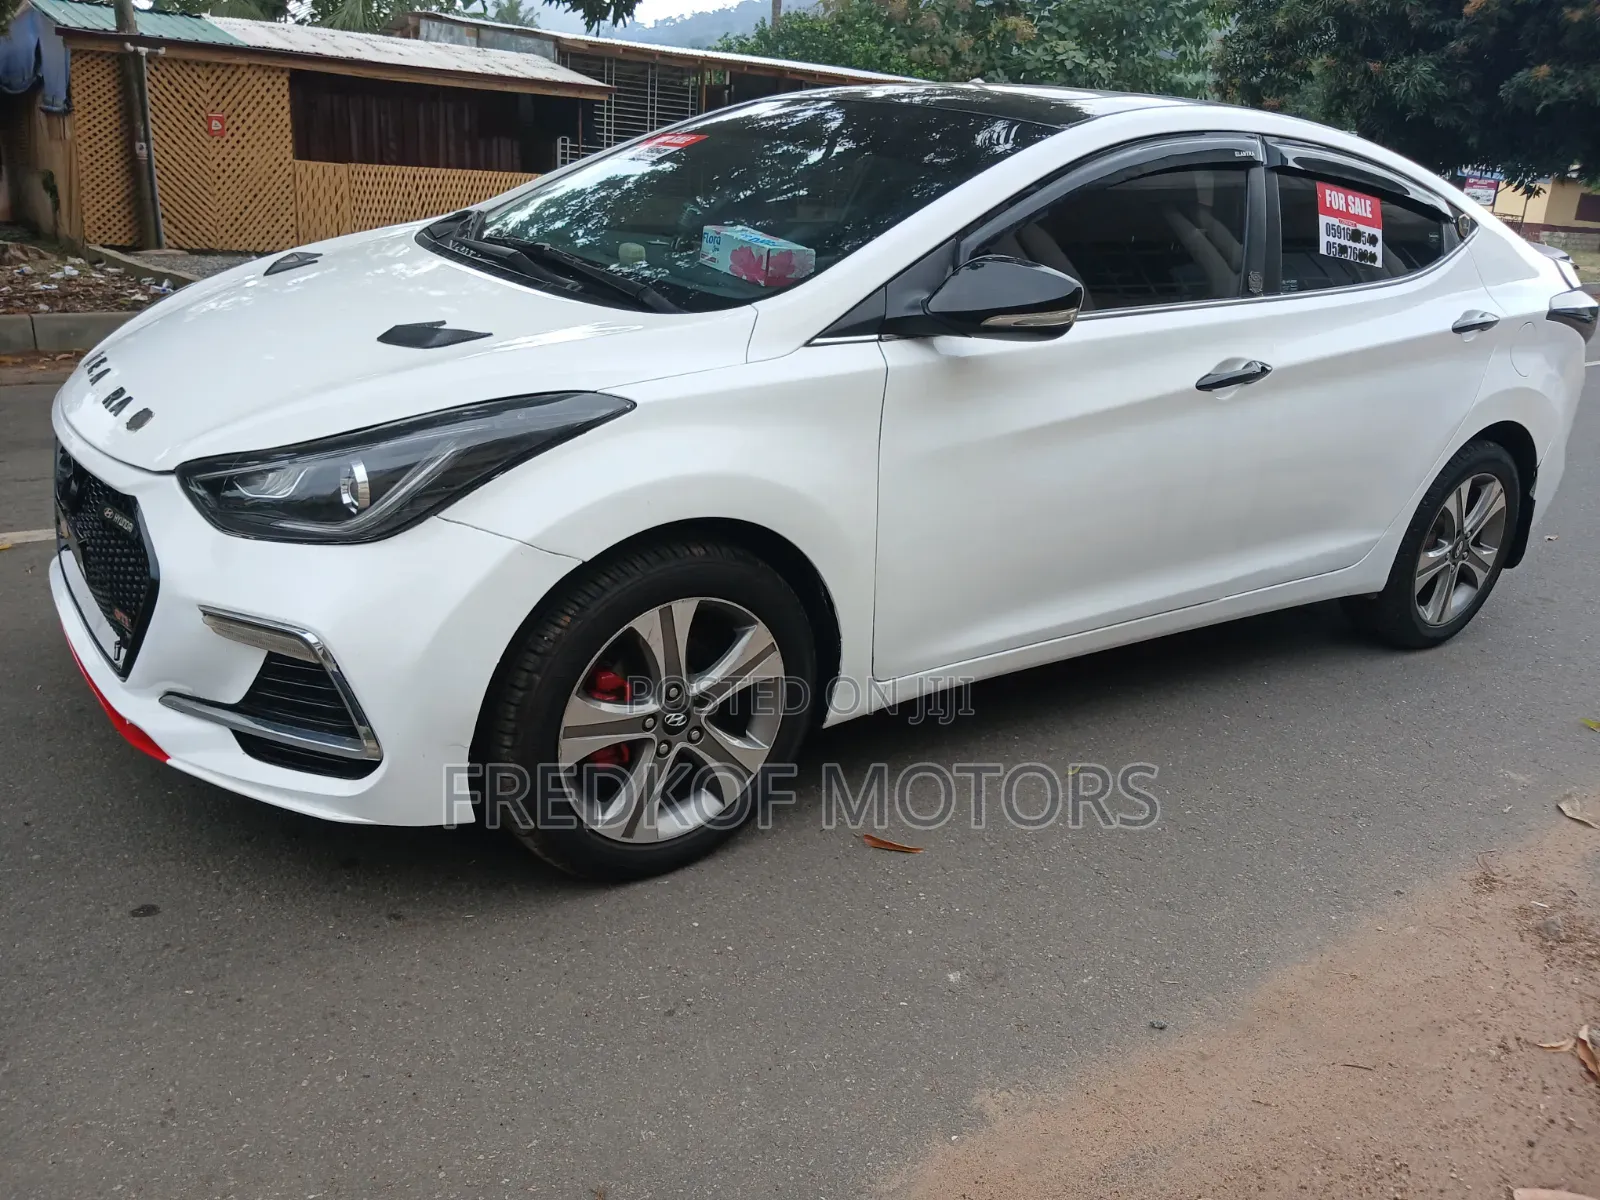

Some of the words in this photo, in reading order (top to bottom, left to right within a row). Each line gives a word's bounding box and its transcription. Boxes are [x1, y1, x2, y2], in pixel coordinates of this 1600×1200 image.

[1325, 189, 1347, 213] FOR
[1347, 195, 1373, 219] SALE
[703, 232, 721, 245] Flora
